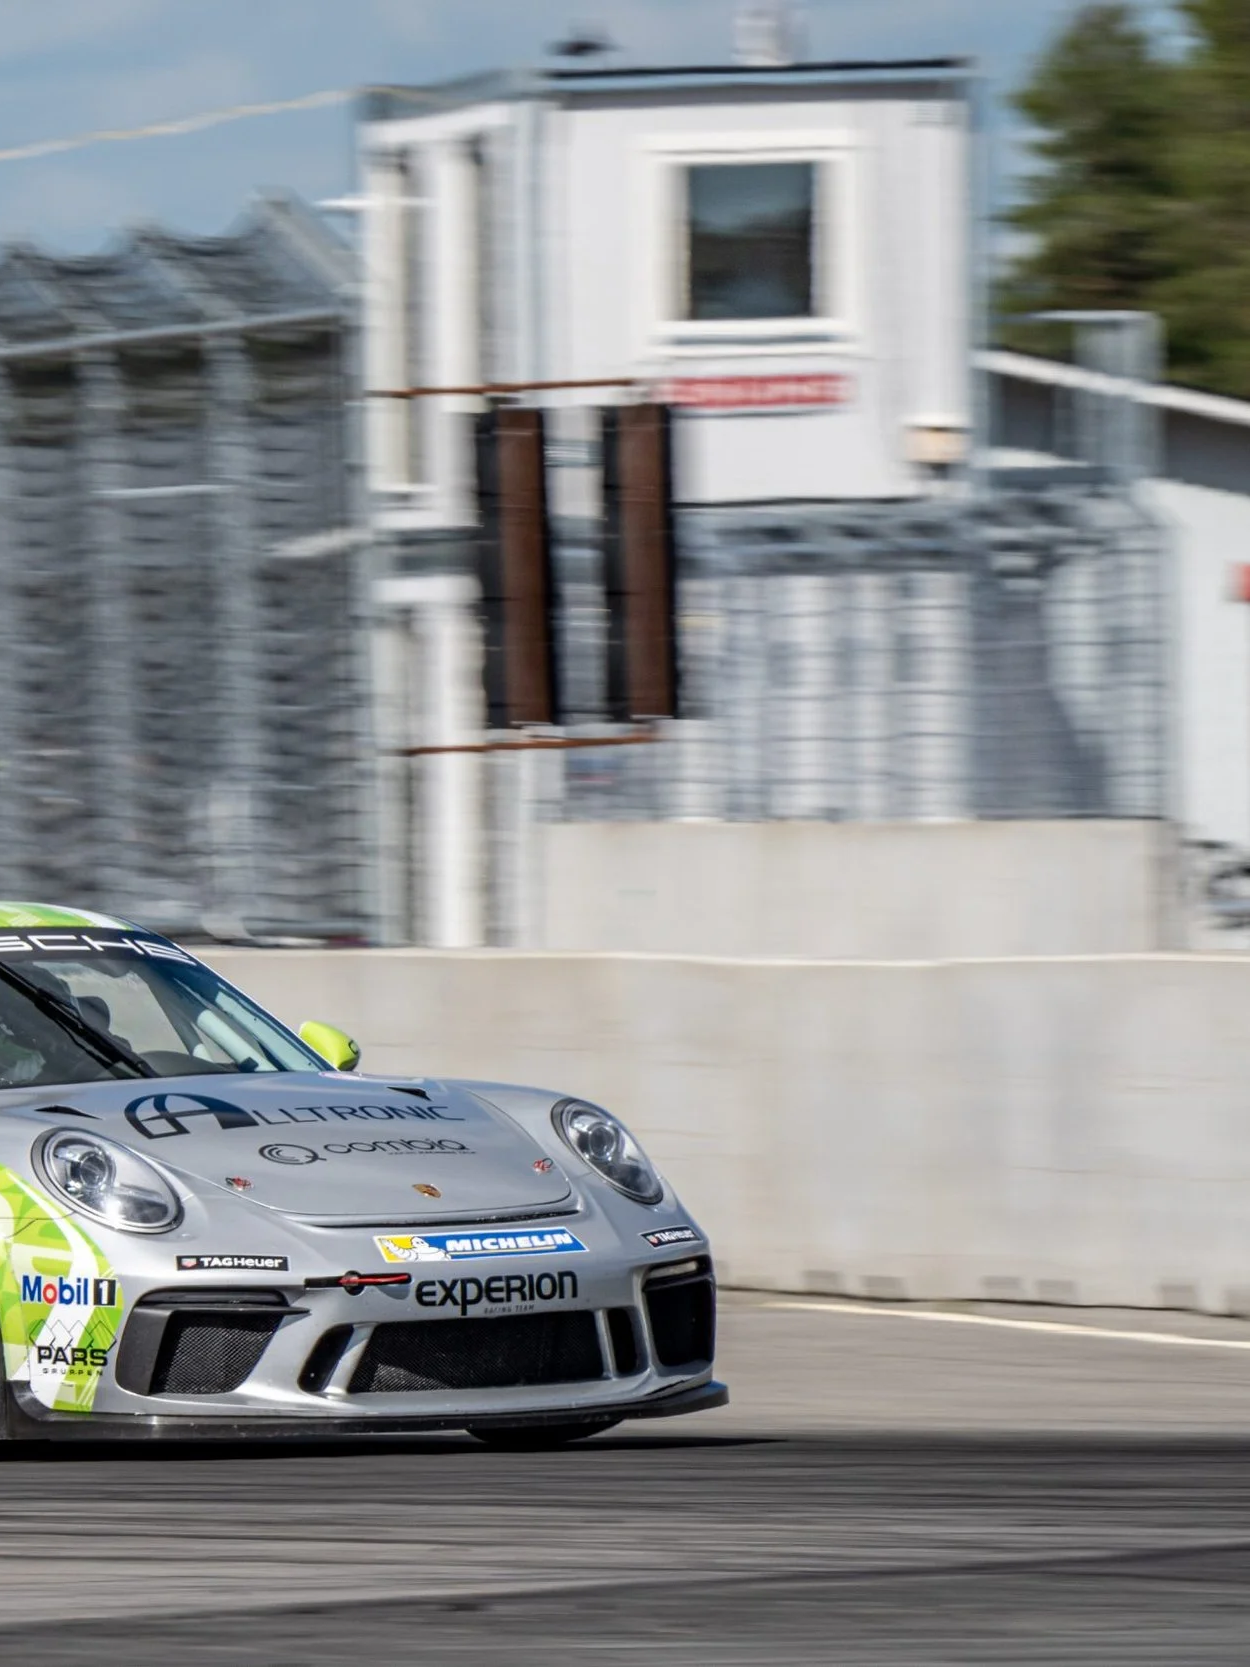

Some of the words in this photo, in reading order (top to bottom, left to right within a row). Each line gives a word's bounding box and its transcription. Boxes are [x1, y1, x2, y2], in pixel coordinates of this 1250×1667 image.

[447, 1232, 573, 1252] MICHELIN
[21, 1275, 89, 1306] Mobil
[37, 1346, 108, 1368] PARS
